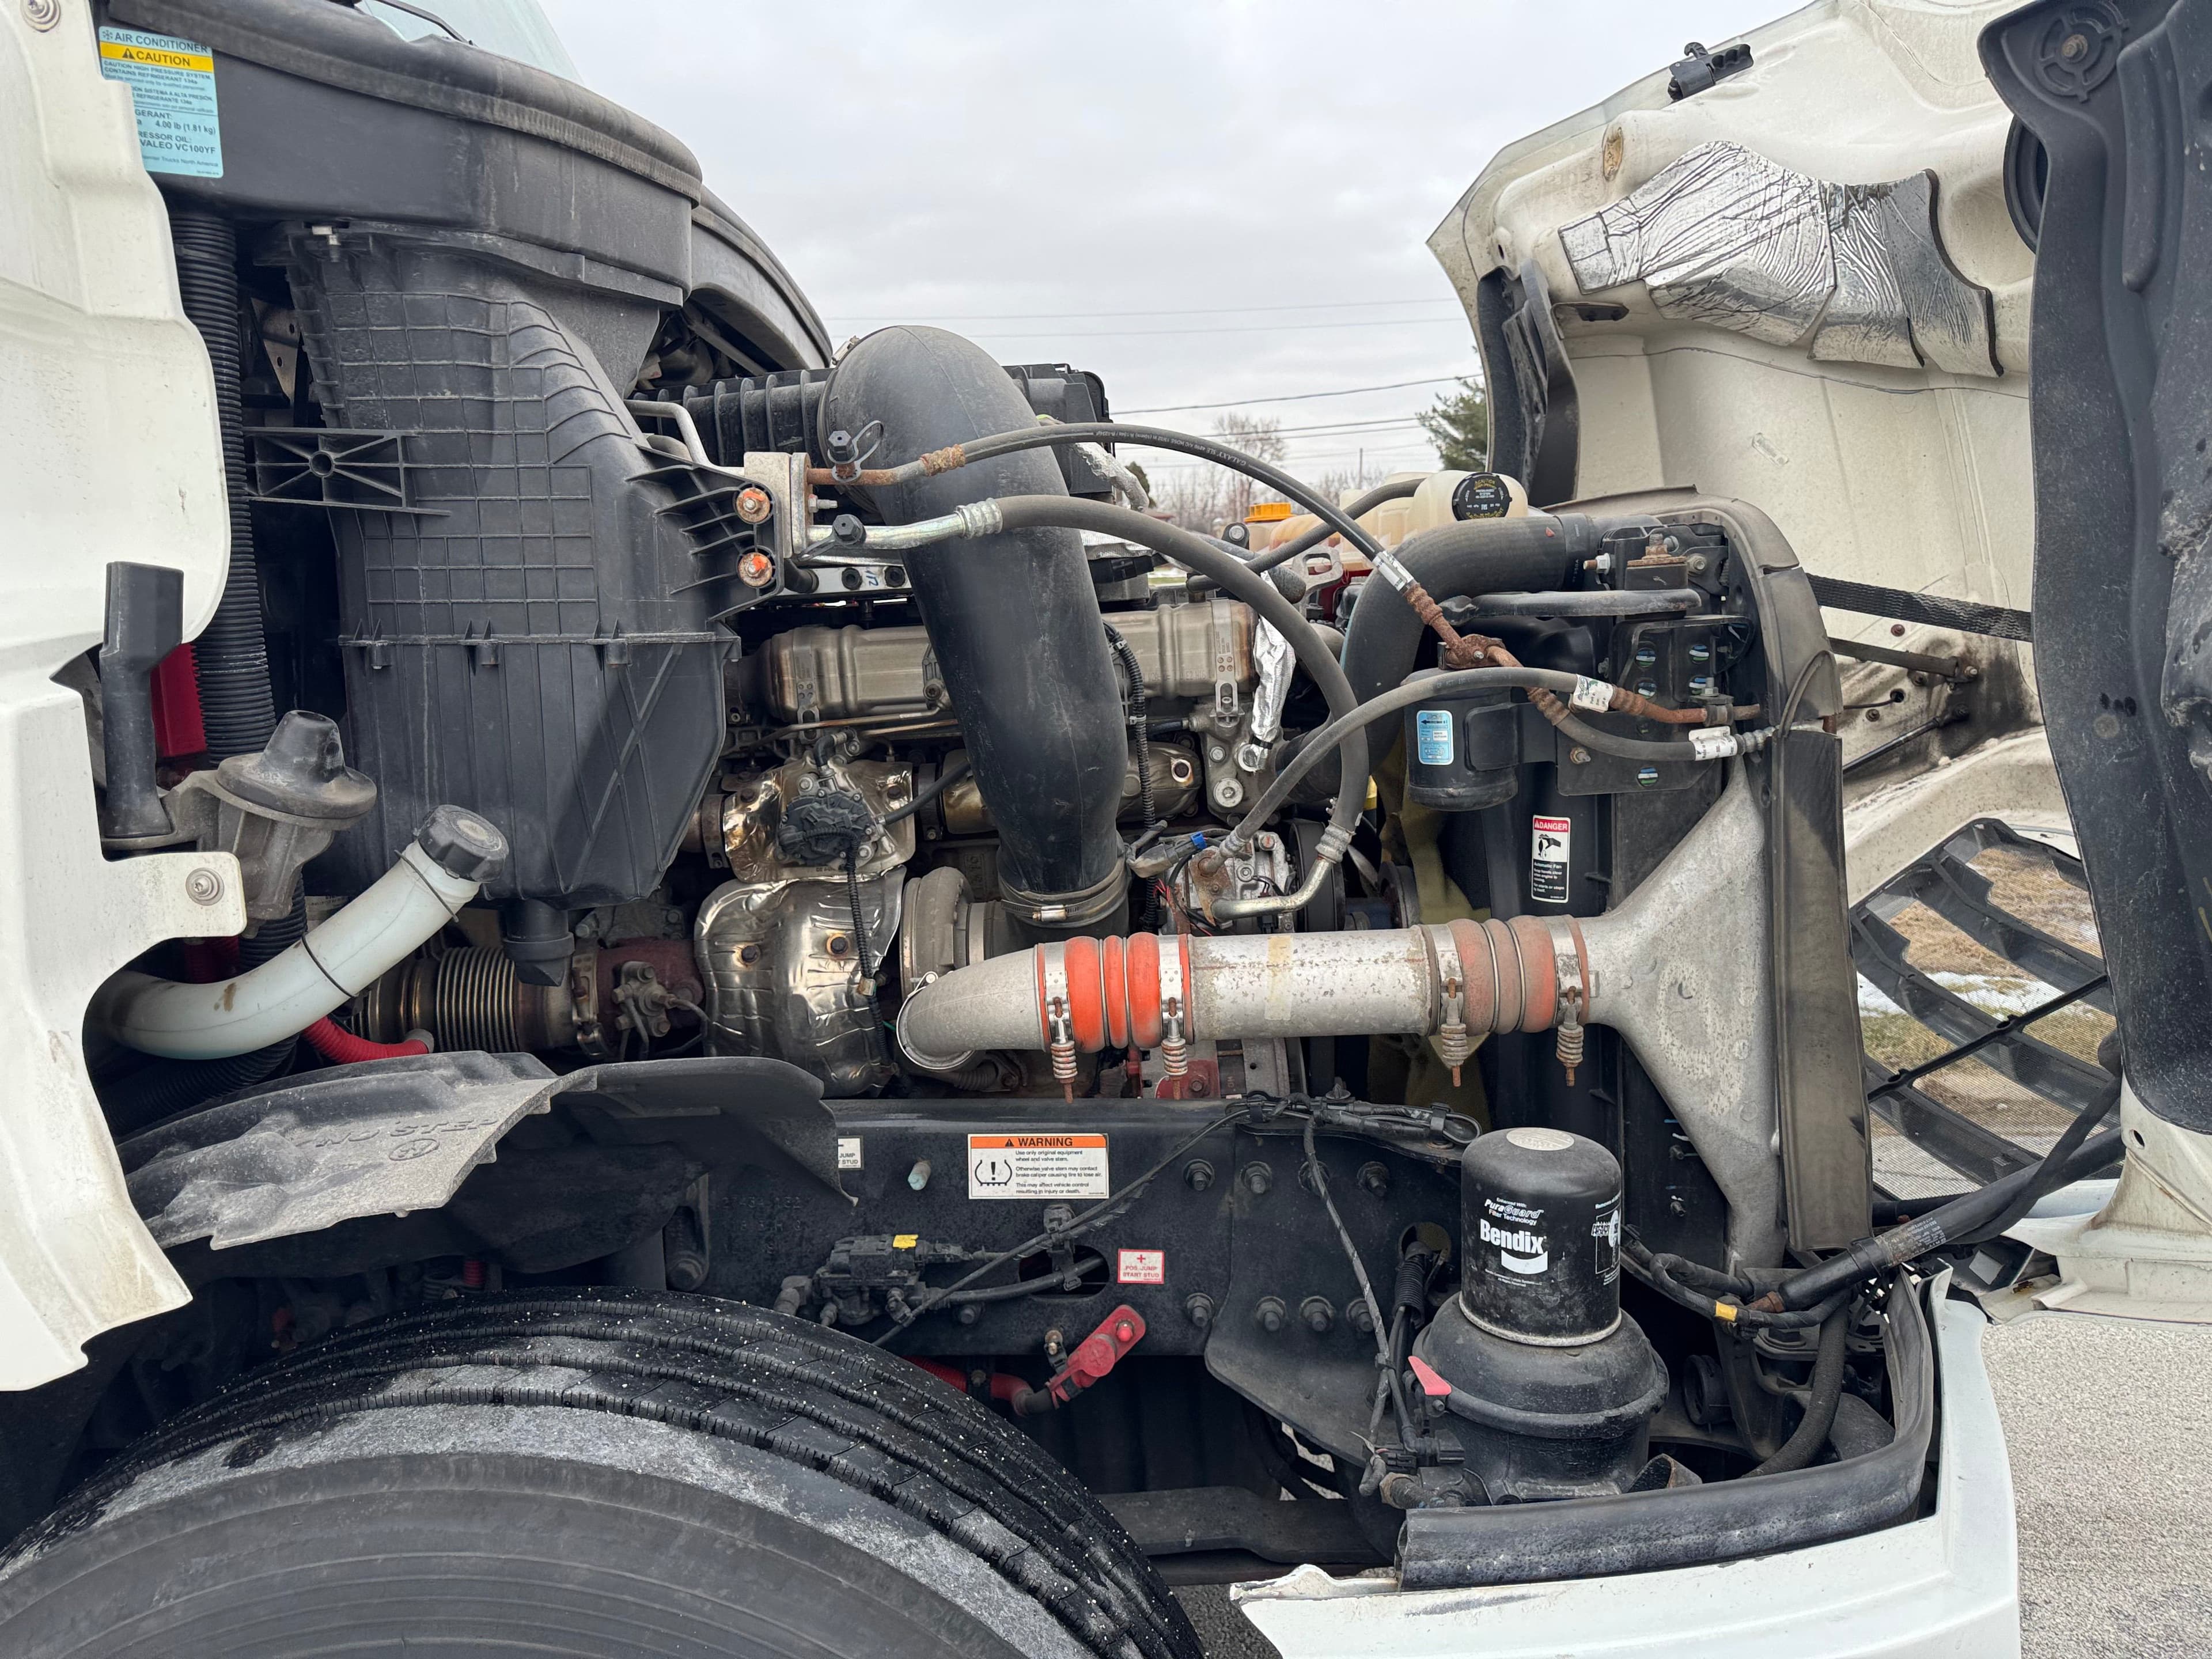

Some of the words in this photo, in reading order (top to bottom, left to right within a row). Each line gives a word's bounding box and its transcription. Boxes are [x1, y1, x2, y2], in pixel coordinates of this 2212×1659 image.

[115, 32, 133, 43] AIR
[136, 36, 207, 53] CONDITIONER
[137, 51, 191, 66] CAUTION
[104, 60, 132, 69] CAUTION
[151, 67, 184, 77] PRESSURE
[104, 67, 137, 75] CONTAINS
[138, 71, 182, 81] REFRIGERANT
[135, 109, 173, 119] GERANT:
[156, 120, 172, 129] 4.00
[183, 123, 202, 132] (1.81
[203, 126, 216, 135] kg)
[138, 130, 173, 141] RESSOR
[139, 139, 172, 149] VALEO
[175, 143, 216, 154] VC100YF
[1217, 452, 1247, 466] GALAXY
[1539, 823, 1567, 831] DANGER
[1018, 1138, 1073, 1147] WARNING
[1484, 1198, 1541, 1219] PuraGuard
[1489, 1209, 1502, 1218] Filter
[1503, 1214, 1537, 1226] Technology
[1480, 1218, 1544, 1254] Bendix
